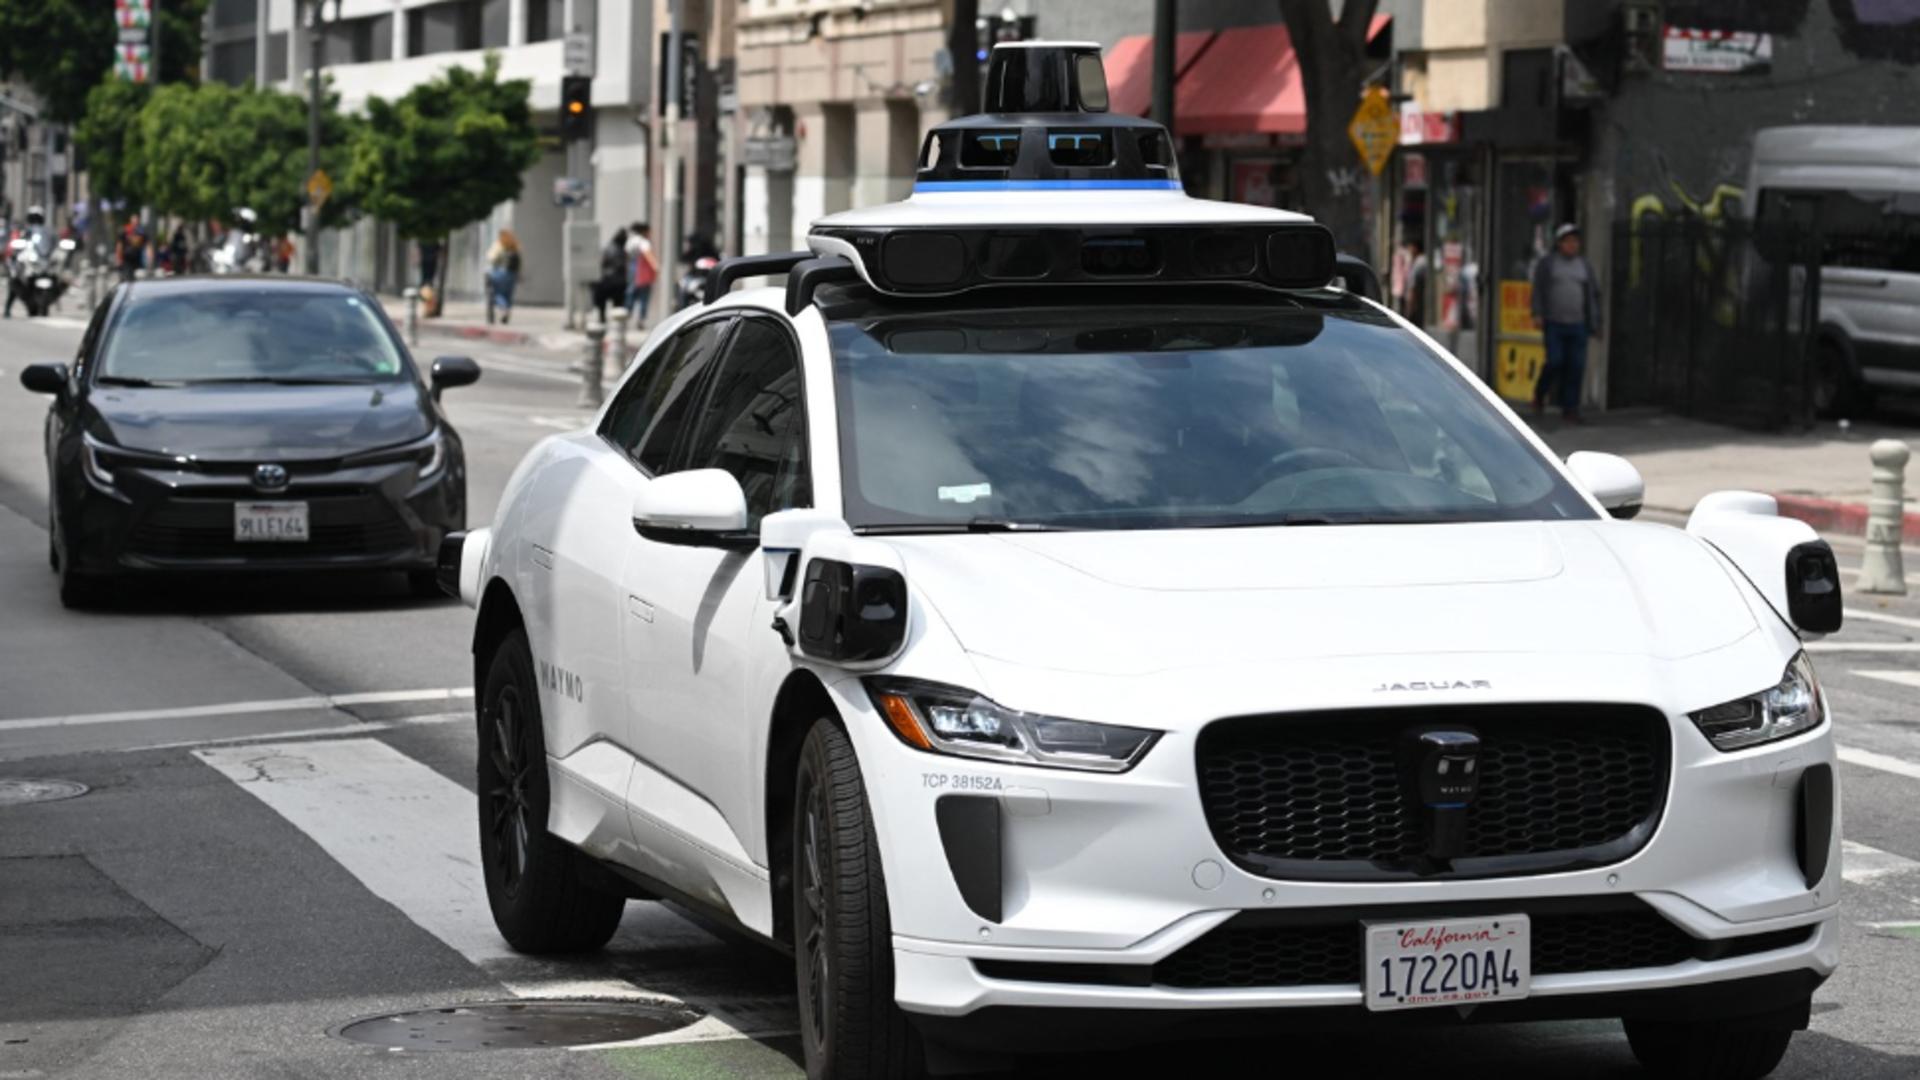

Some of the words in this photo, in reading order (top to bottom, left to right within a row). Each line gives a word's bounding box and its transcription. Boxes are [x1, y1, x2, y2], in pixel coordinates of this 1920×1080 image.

[539, 660, 583, 704] WAYMO
[1372, 679, 1492, 693] JAGUAR
[921, 773, 948, 789] TCP
[951, 774, 1003, 790] 38152A
[1400, 925, 1500, 951] California
[1379, 948, 1520, 998] 17220A4
